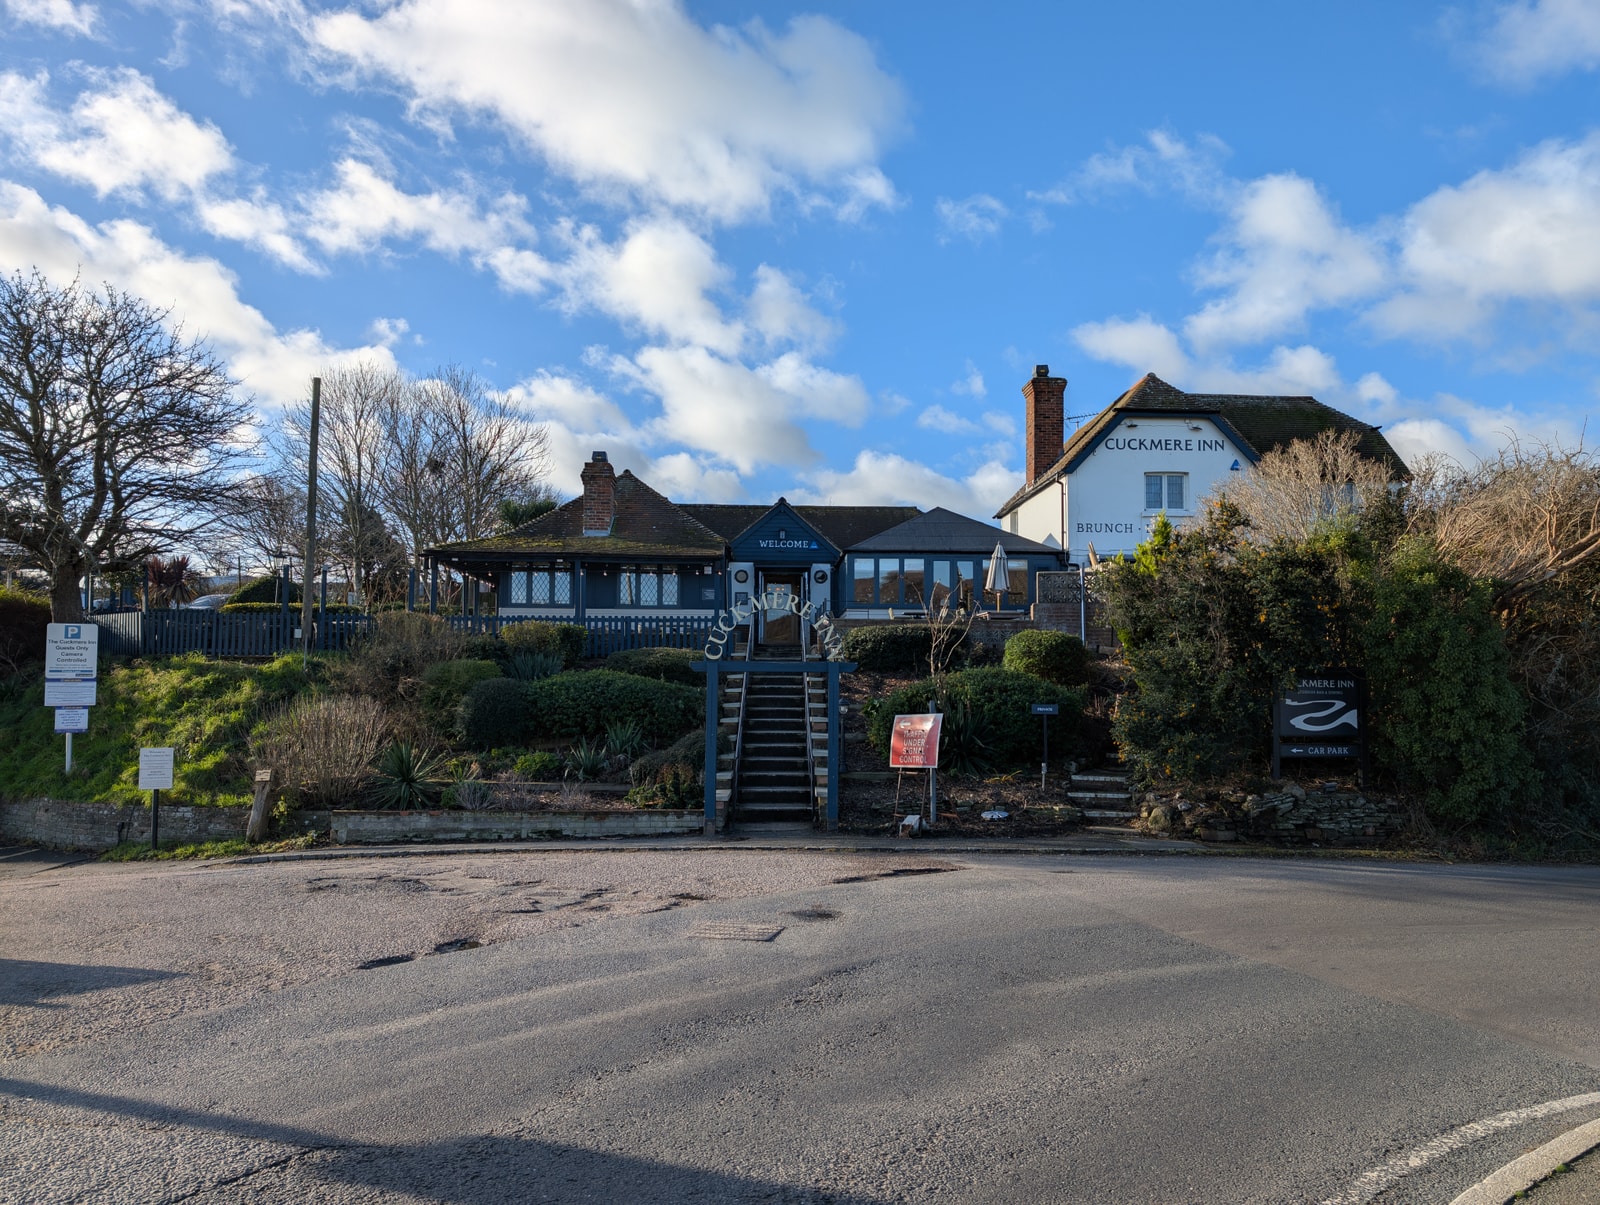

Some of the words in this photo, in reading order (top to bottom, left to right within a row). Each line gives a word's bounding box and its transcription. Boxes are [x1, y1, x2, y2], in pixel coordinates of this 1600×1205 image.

[1105, 438, 1193, 451] CUCKMERE
[1197, 439, 1225, 452] INN
[1077, 523, 1133, 534] BRUNCH
[759, 540, 809, 549] WELCOME
[704, 591, 816, 660] CUCKMERE
[811, 613, 845, 660] INN
[68, 626, 79, 638] P
[1298, 679, 1335, 688] KMERE
[1337, 680, 1354, 688] INN
[904, 730, 927, 739] TRAFFIC
[904, 739, 925, 747] UNDER
[902, 747, 925, 755] SIGNAL
[1308, 747, 1325, 755] CAR
[1327, 747, 1349, 755] PARK
[899, 755, 927, 764] CONTROL
